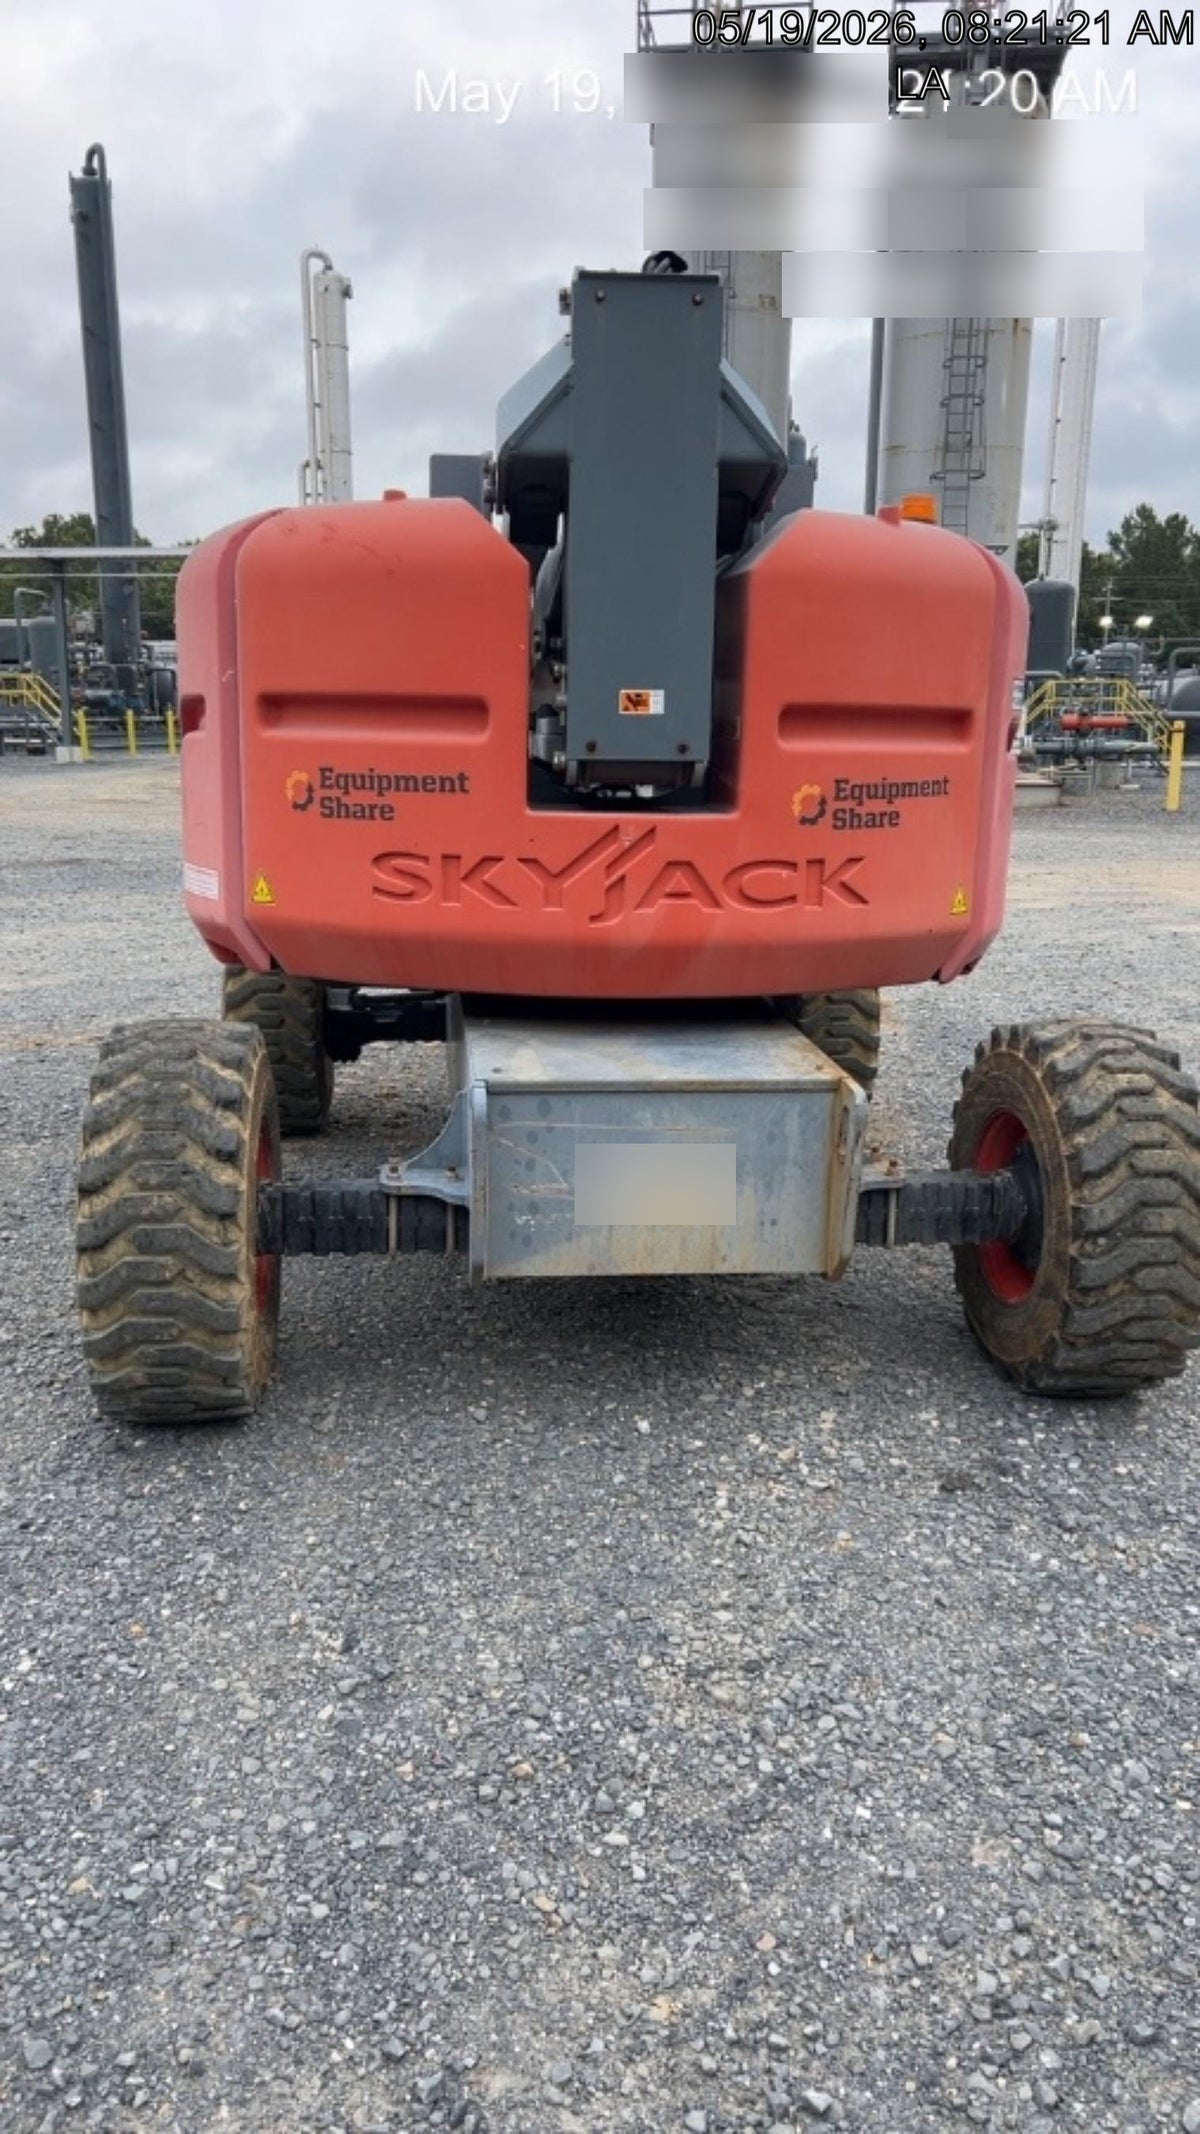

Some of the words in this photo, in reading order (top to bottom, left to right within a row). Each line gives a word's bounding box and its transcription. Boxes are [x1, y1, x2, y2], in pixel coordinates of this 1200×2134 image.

[319, 767, 470, 797] Equipment
[832, 775, 950, 805] Equipment
[319, 796, 395, 821] Share
[831, 806, 900, 831] Share
[370, 824, 870, 928] SKYJACK
